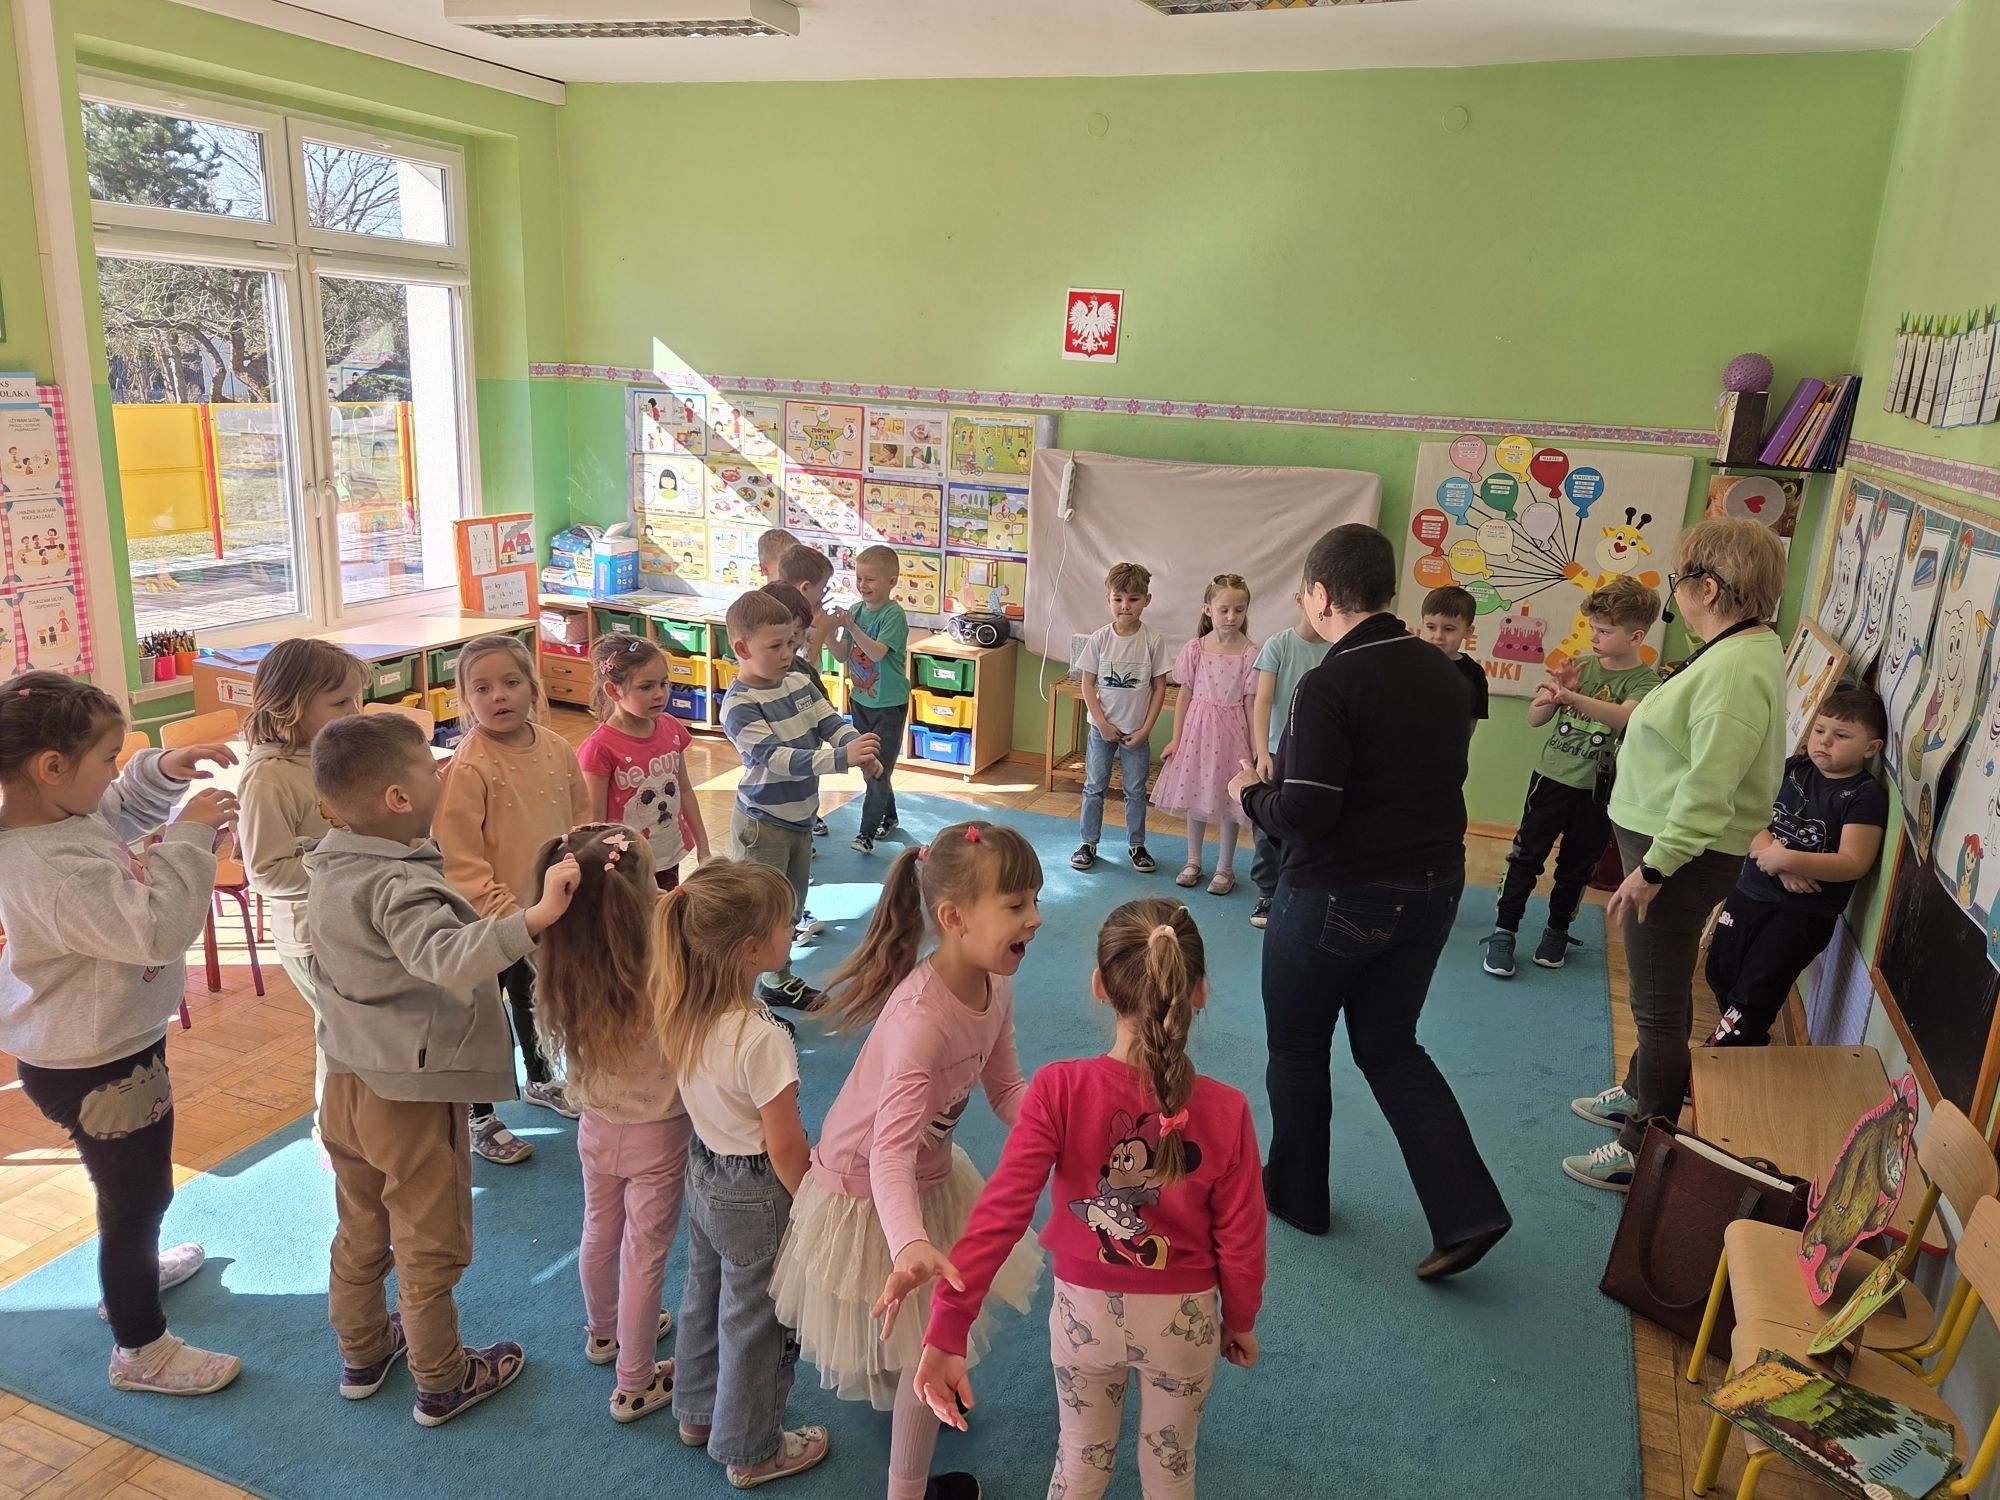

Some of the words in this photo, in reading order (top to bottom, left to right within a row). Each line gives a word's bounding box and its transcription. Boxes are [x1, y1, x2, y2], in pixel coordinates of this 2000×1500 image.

[614, 766, 644, 790] be
[649, 751, 680, 777] cut
[1868, 1438, 1922, 1480] GRUFFALO
